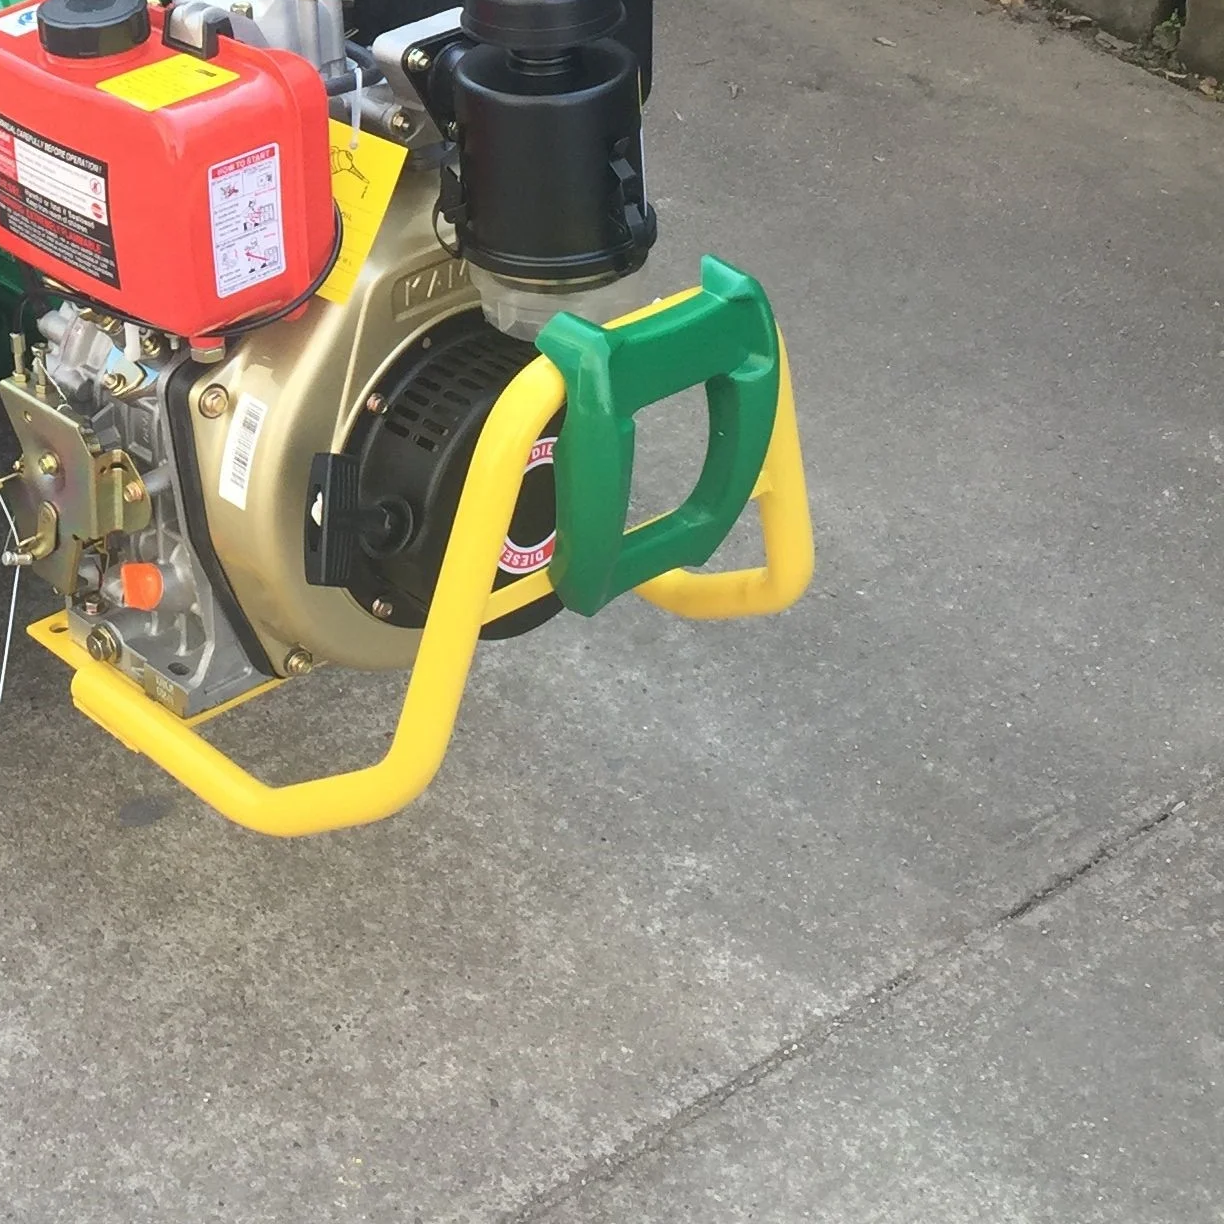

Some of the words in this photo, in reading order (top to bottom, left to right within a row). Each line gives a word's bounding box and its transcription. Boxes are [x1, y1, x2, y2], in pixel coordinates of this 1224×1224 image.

[44, 142, 66, 158] BEFORE
[236, 159, 246, 169] TO
[246, 149, 271, 167] START
[531, 443, 554, 460] DIE
